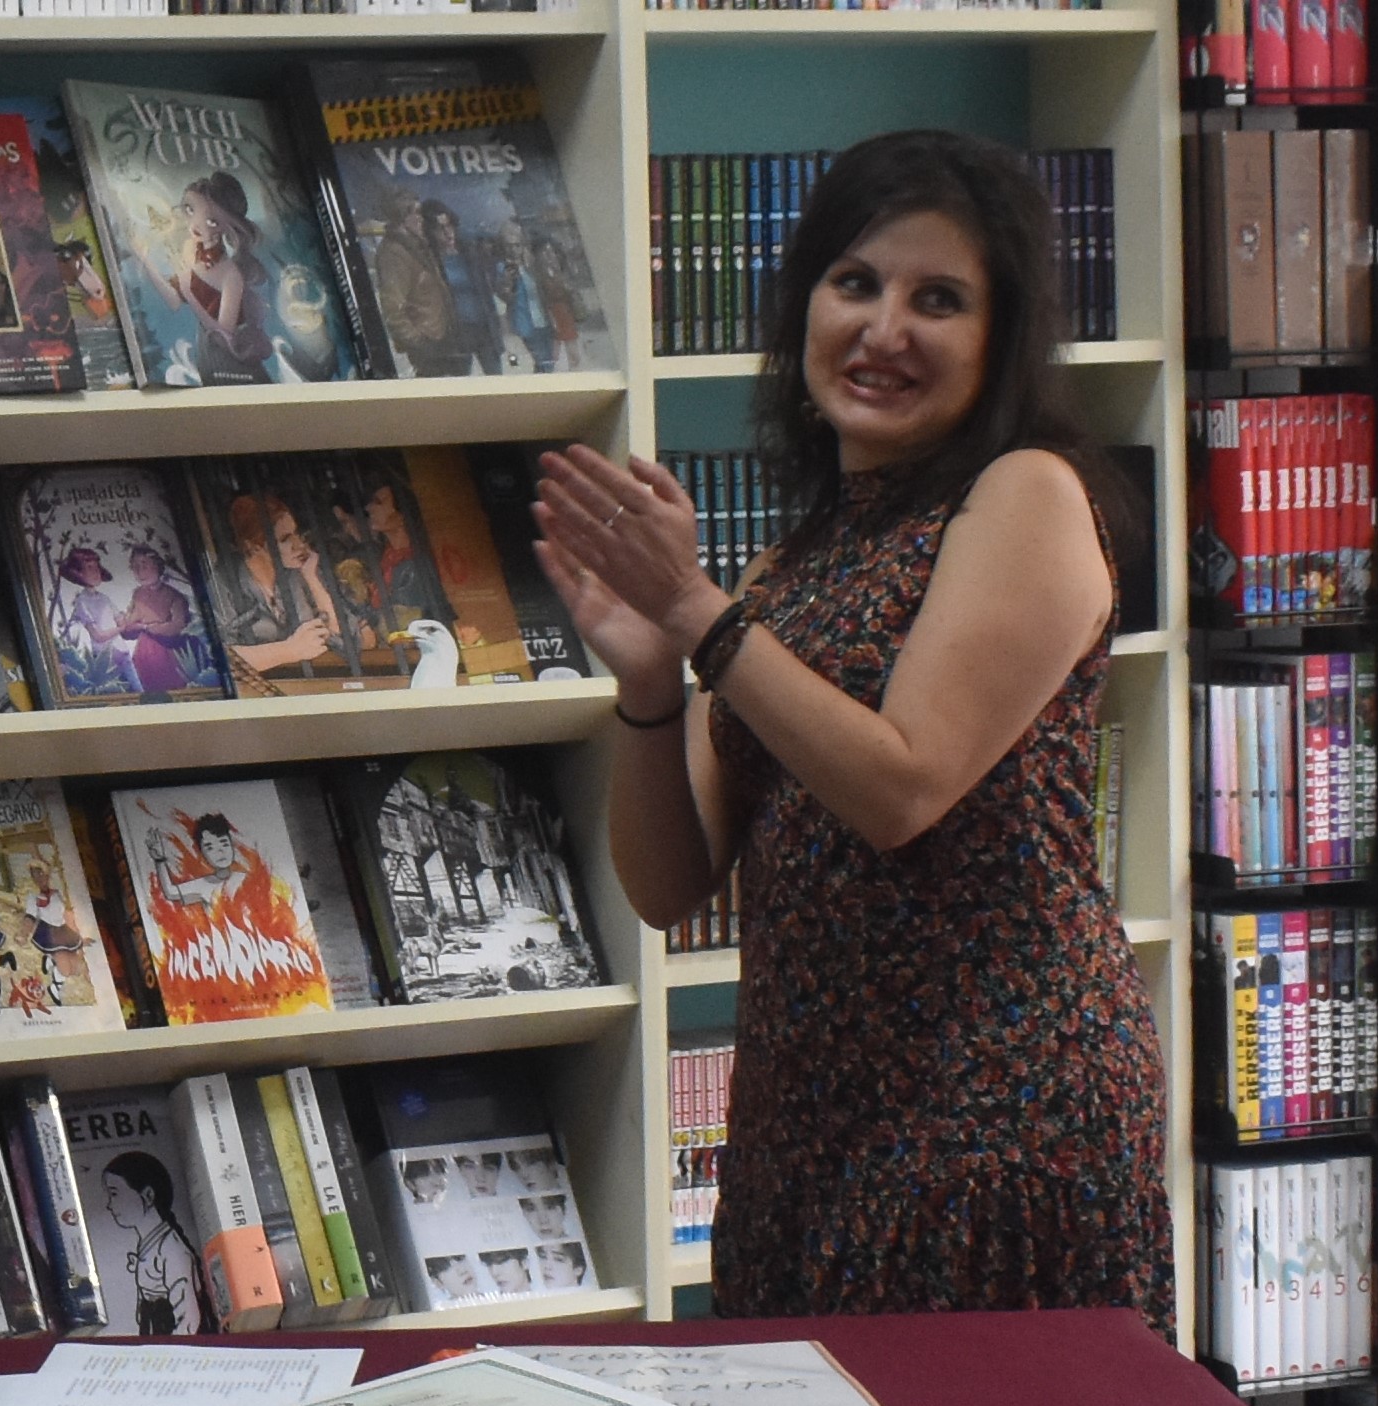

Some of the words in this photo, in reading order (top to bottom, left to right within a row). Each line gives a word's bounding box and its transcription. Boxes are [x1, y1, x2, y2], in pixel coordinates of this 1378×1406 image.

[374, 144, 523, 176] VOITRES
[72, 1111, 158, 1143] ERBA
[1215, 1247, 1225, 1281] 1
[1264, 1280, 1276, 1303] 2
[1289, 1279, 1300, 1301] 3
[1309, 1280, 1322, 1300] 4
[1334, 1274, 1346, 1297] 5
[1357, 1271, 1371, 1293] 6
[1242, 1284, 1249, 1306] 1
